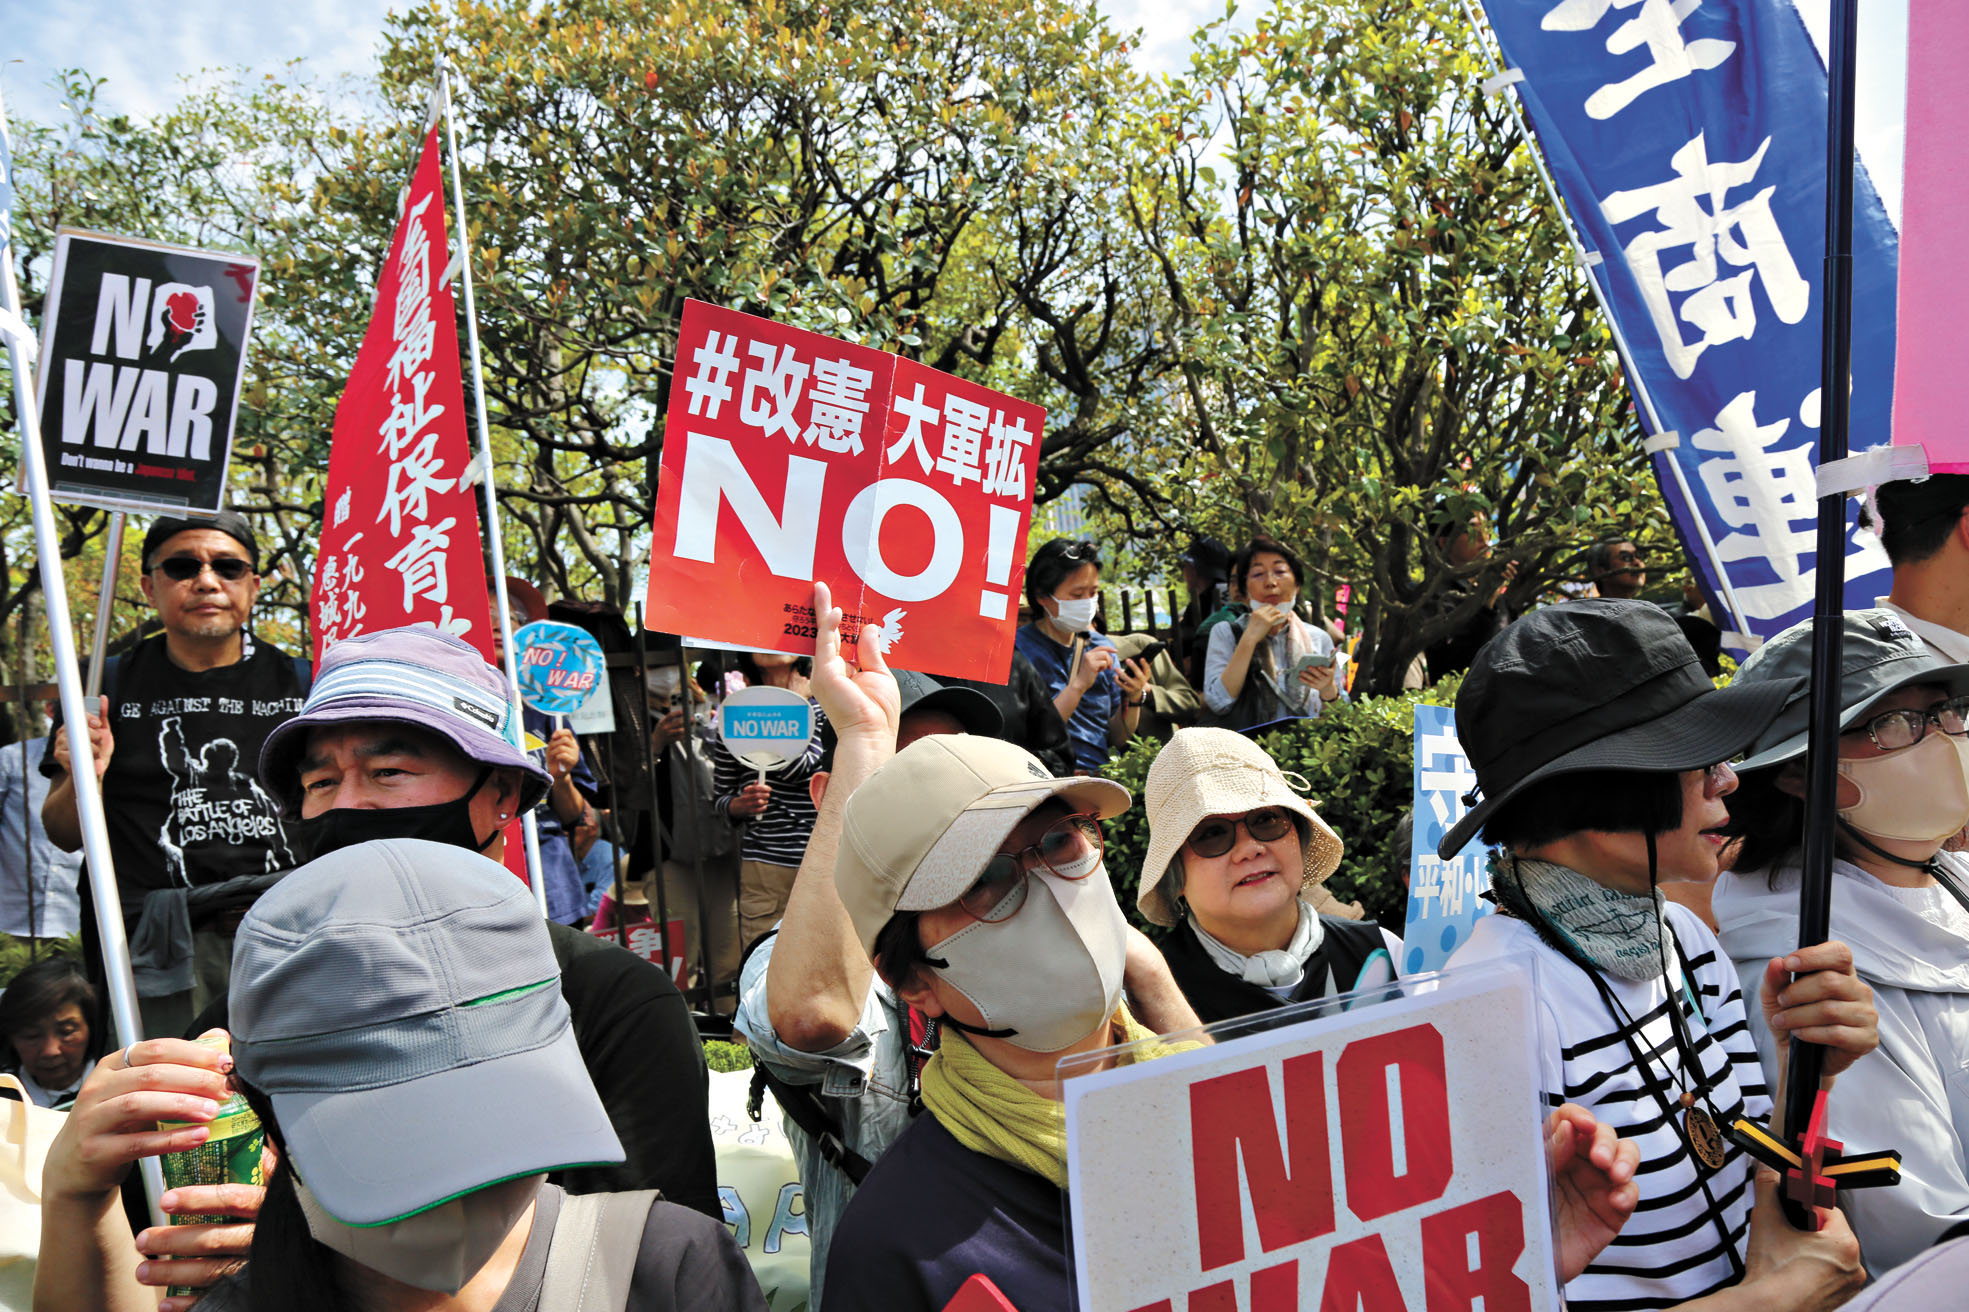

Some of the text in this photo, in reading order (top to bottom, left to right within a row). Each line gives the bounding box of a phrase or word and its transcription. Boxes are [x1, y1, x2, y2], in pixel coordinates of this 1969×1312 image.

[61, 358, 218, 461] WAR
[685, 330, 1033, 501] #改憲 大軍拡
[673, 431, 1021, 620] NO!
[342, 532, 367, 638] 一九九
[546, 668, 595, 690] WAR
[219, 697, 245, 714] THE
[733, 720, 800, 737] NO WAR
[178, 788, 208, 807] THE
[178, 799, 254, 825] BATTLE OF
[180, 825, 207, 847] LOS
[1190, 1023, 1453, 1272] NO
